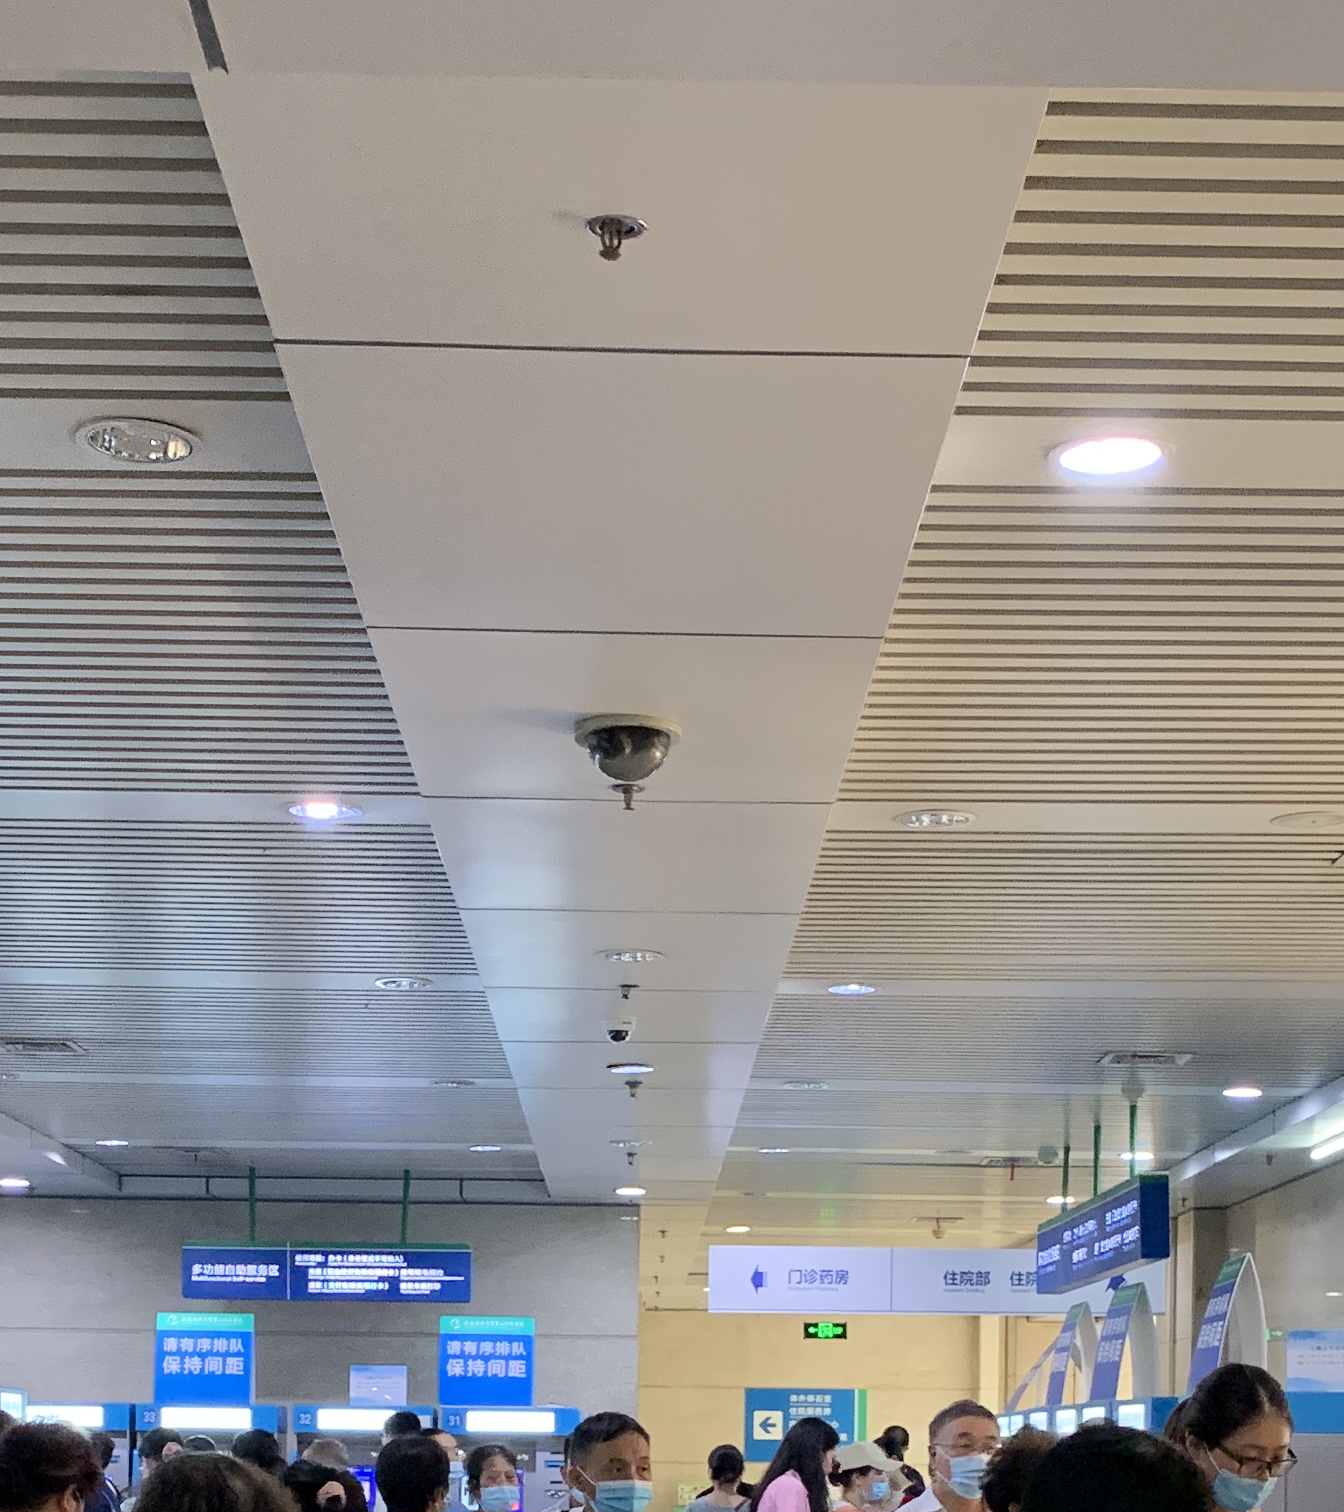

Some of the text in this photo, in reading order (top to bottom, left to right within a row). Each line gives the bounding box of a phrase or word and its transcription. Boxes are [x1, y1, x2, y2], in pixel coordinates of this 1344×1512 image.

[787, 1269, 849, 1285] 门诊药房
[943, 1270, 990, 1287] 住院部
[163, 1337, 244, 1353] 请有序排队
[446, 1340, 526, 1356] 请有序排队
[163, 1356, 244, 1375] 保持间距
[446, 1358, 526, 1378] 保持间距
[143, 1412, 156, 1423] 33
[298, 1413, 312, 1425] 32
[448, 1415, 460, 1426] 31
